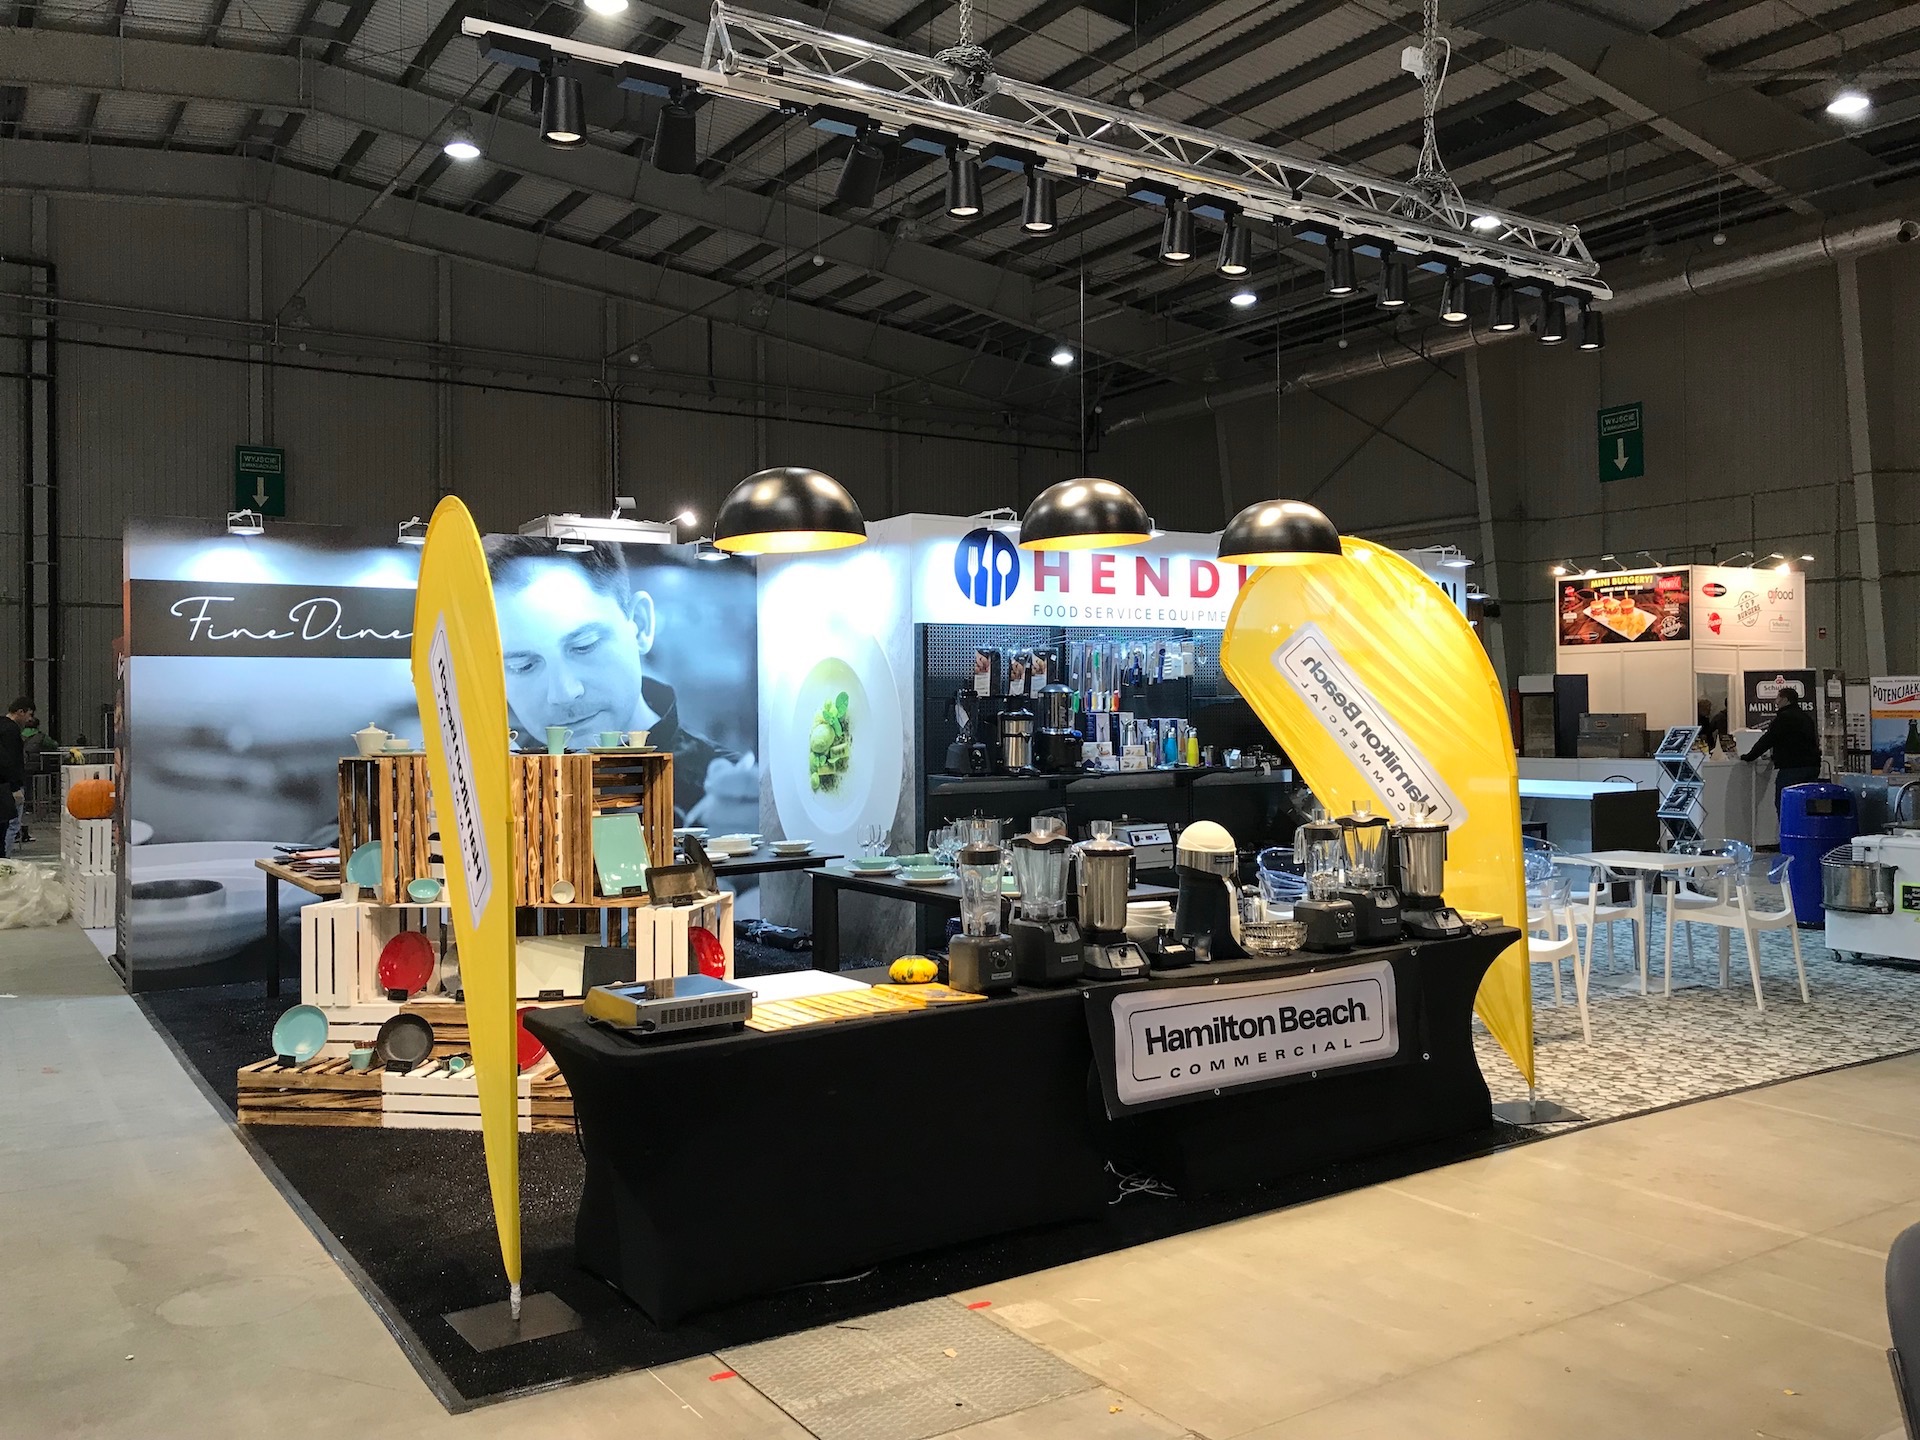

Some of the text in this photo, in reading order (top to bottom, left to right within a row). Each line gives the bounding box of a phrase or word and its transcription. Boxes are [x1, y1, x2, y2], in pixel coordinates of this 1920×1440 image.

[1590, 577, 1611, 589] MINI
[1033, 604, 1227, 623] FOOD SERVICE EQUIPME
[1737, 604, 1761, 620] BURGERS
[1739, 600, 1755, 611] TOP
[170, 596, 294, 642] Fine
[1872, 683, 1920, 702] POTENCJAŁK
[1748, 702, 1772, 712] MINI
[1145, 997, 1367, 1056] Hamilton Beach
[1169, 1037, 1353, 1080] COMMERCIAL
